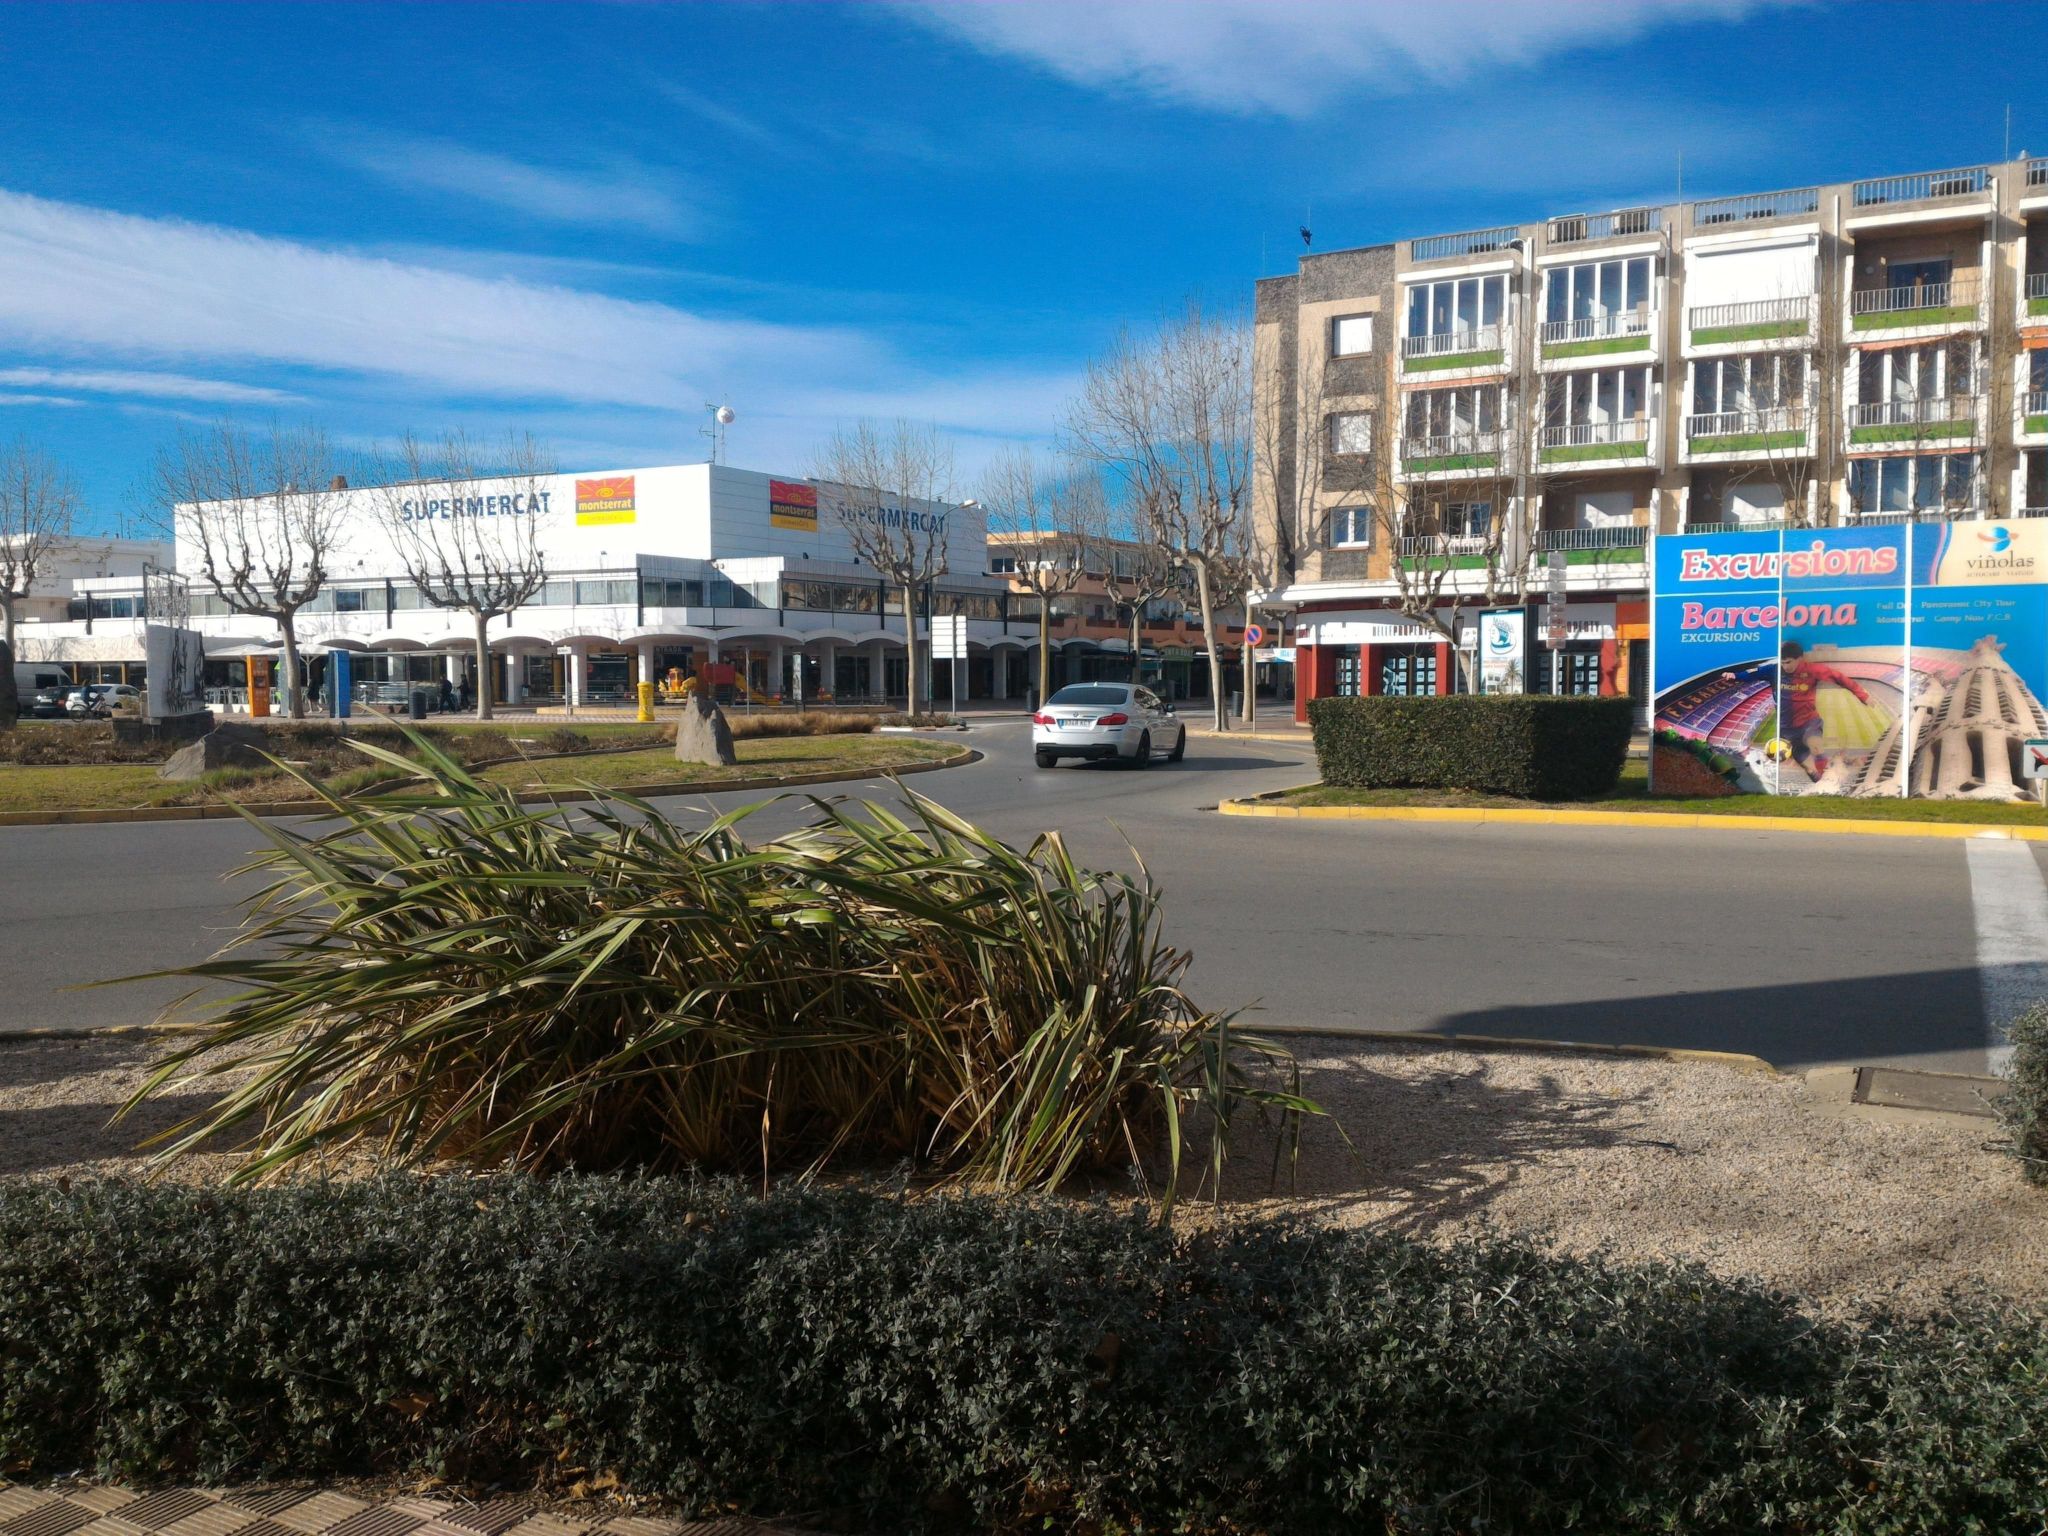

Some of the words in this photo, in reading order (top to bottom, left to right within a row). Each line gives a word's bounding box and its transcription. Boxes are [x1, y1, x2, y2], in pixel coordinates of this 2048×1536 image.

[402, 492, 551, 522] SUPERMERCAT
[578, 499, 632, 511] montserrat
[772, 503, 815, 518] montserrat
[838, 501, 945, 534] SUPERMERCAT
[1680, 540, 1897, 581] Excursions
[1967, 550, 2035, 568] viñolas
[1681, 598, 1857, 629] Barcelona
[1681, 632, 1760, 643] EXCURSIONS
